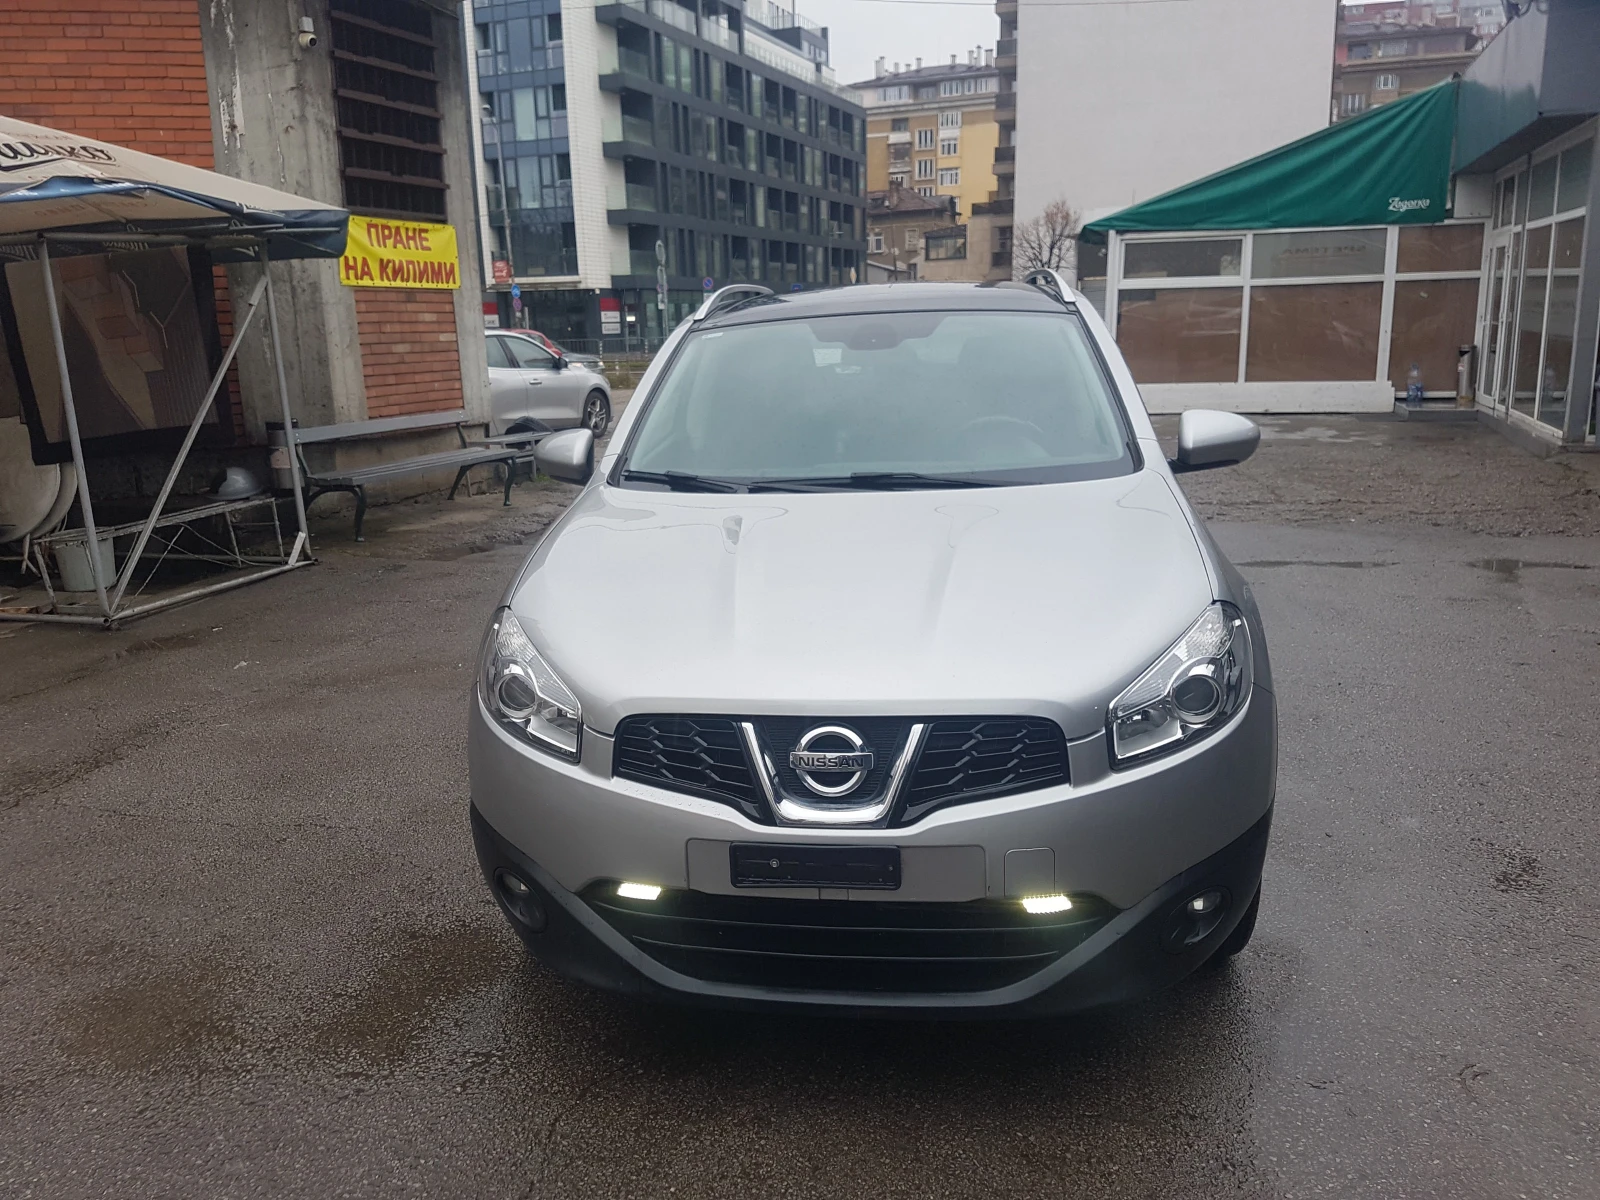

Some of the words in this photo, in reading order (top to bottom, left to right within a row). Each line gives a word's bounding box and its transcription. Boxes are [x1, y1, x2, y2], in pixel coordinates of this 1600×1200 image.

[366, 223, 432, 251] ПРАНЕ
[344, 255, 375, 281] НА
[379, 258, 456, 285] КИЛИМИ
[798, 756, 864, 768] NISSAN
